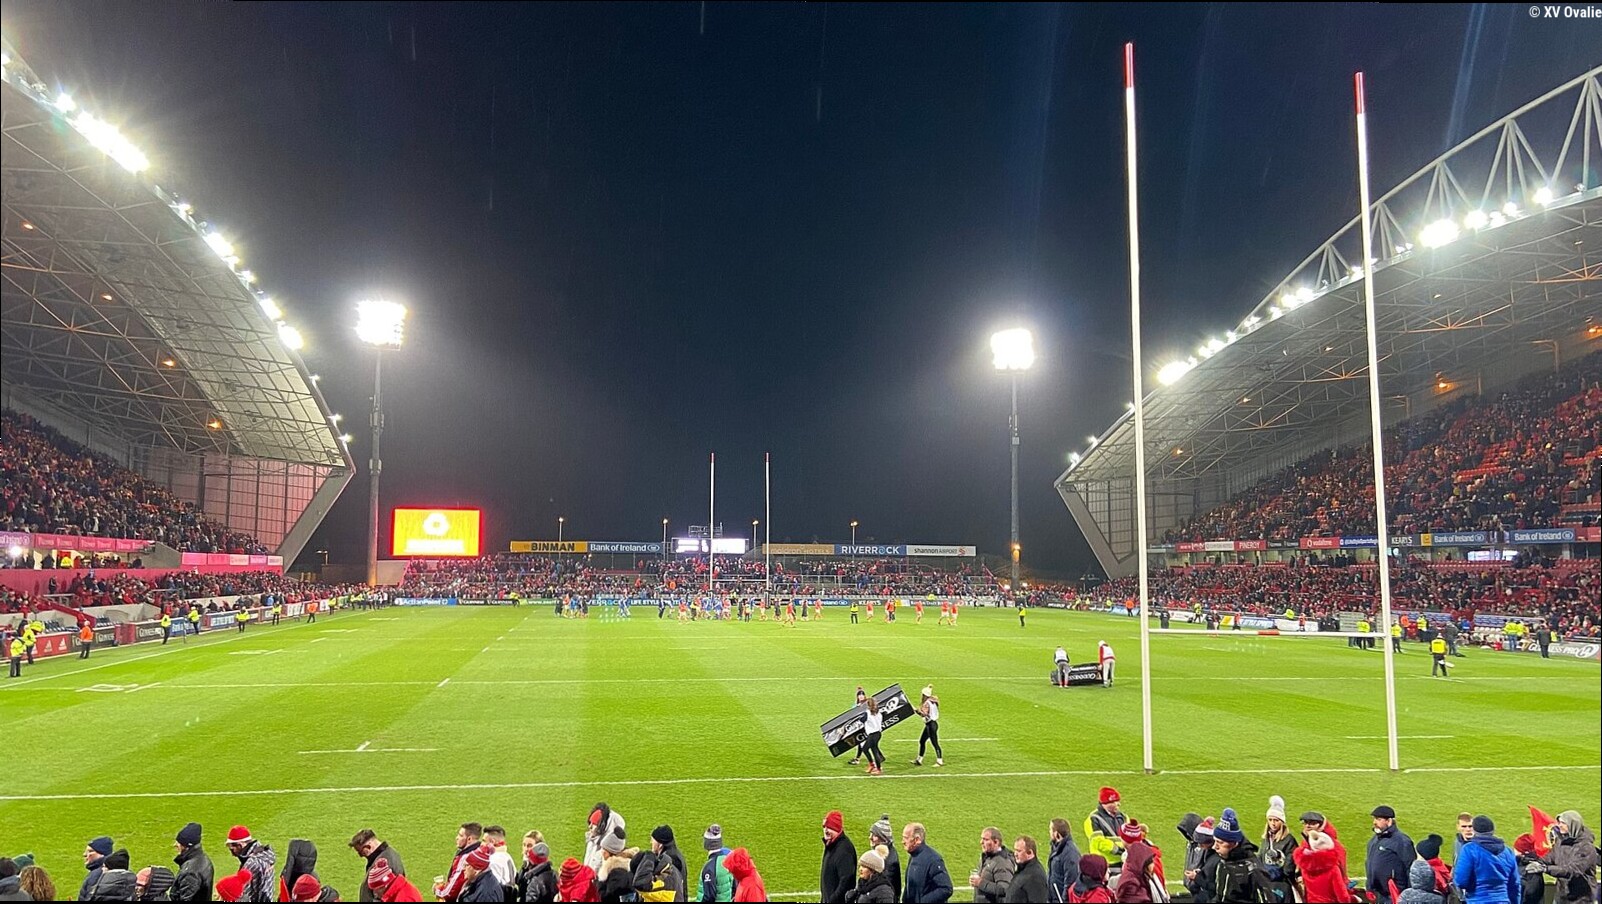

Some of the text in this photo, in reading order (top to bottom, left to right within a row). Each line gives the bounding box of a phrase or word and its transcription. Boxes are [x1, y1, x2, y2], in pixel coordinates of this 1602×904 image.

[1434, 535, 1448, 543] Bank
[1455, 534, 1475, 542] Ireland
[1514, 532, 1531, 541] Bank
[1538, 532, 1561, 540] Ireland
[531, 542, 575, 552] BINMAN
[590, 543, 647, 552] Bank of Ireland
[841, 545, 900, 555] RIVERROCK
